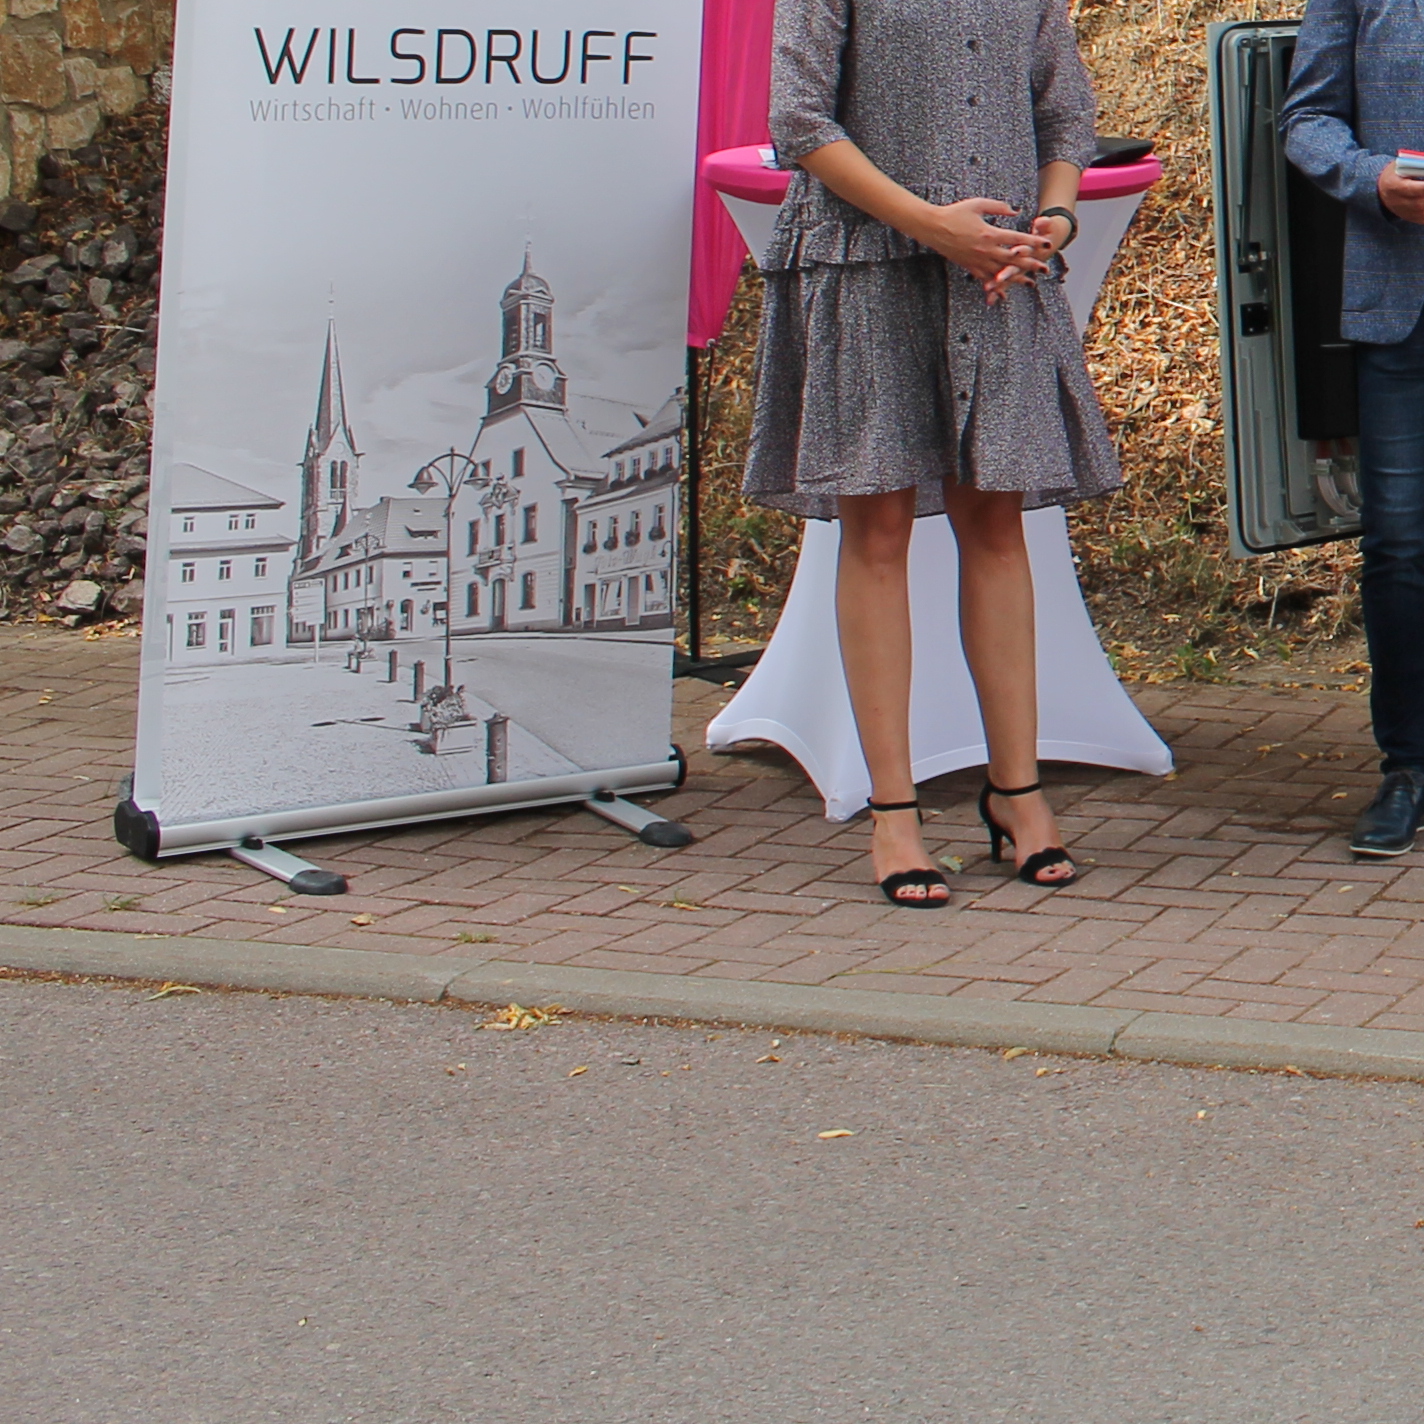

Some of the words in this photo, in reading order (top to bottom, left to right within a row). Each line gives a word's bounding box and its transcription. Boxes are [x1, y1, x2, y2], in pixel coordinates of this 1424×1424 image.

[253, 27, 658, 85] WILSDRUFF
[250, 96, 376, 121] Wirtschaft
[400, 96, 499, 120] Wohnen
[522, 95, 656, 120] Wohlfühlen
